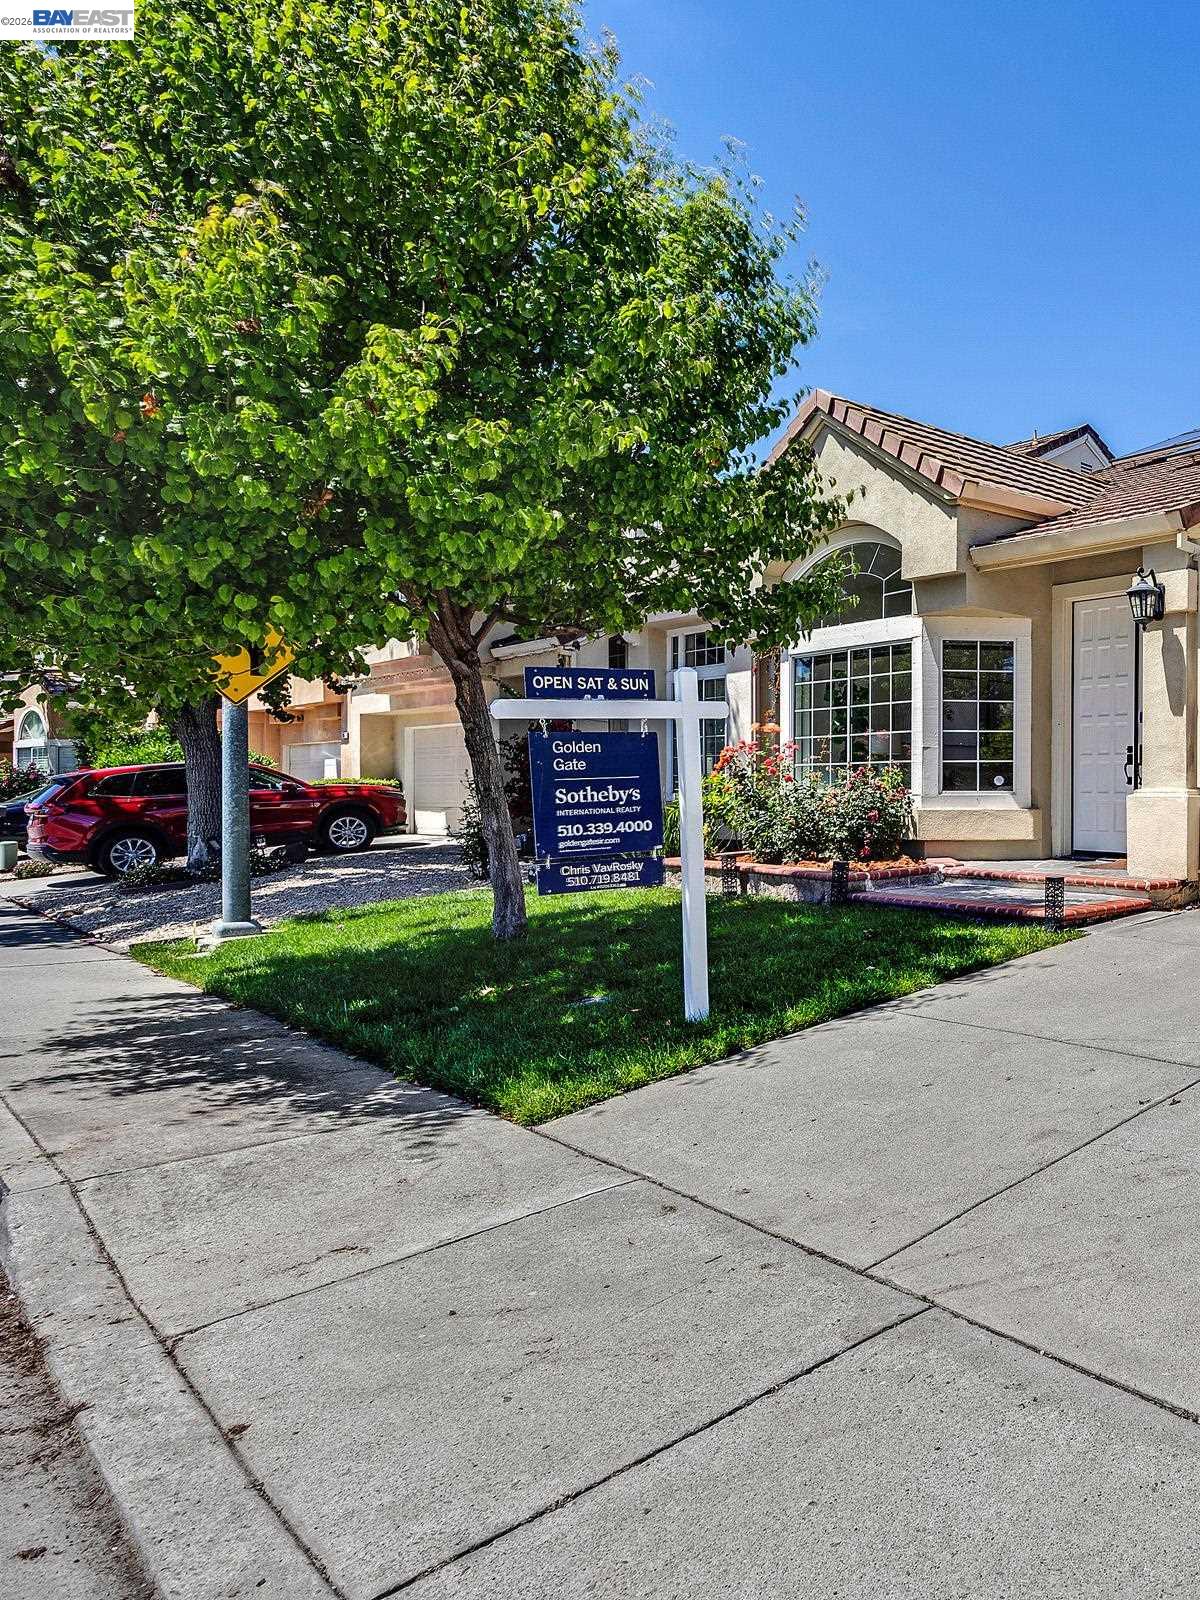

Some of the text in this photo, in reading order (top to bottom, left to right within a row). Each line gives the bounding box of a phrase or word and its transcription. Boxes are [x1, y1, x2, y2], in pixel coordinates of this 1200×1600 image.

[532, 676, 649, 691] OPEN SAT & SUN
[552, 740, 601, 753] Golden
[553, 758, 586, 771] Gate
[554, 785, 641, 805] Sotheby's
[556, 806, 641, 817] INTERNATIONAL REALTY
[557, 820, 653, 837] 510.339.4000
[560, 864, 591, 876] Chris
[565, 871, 640, 887] 510.719.8481
